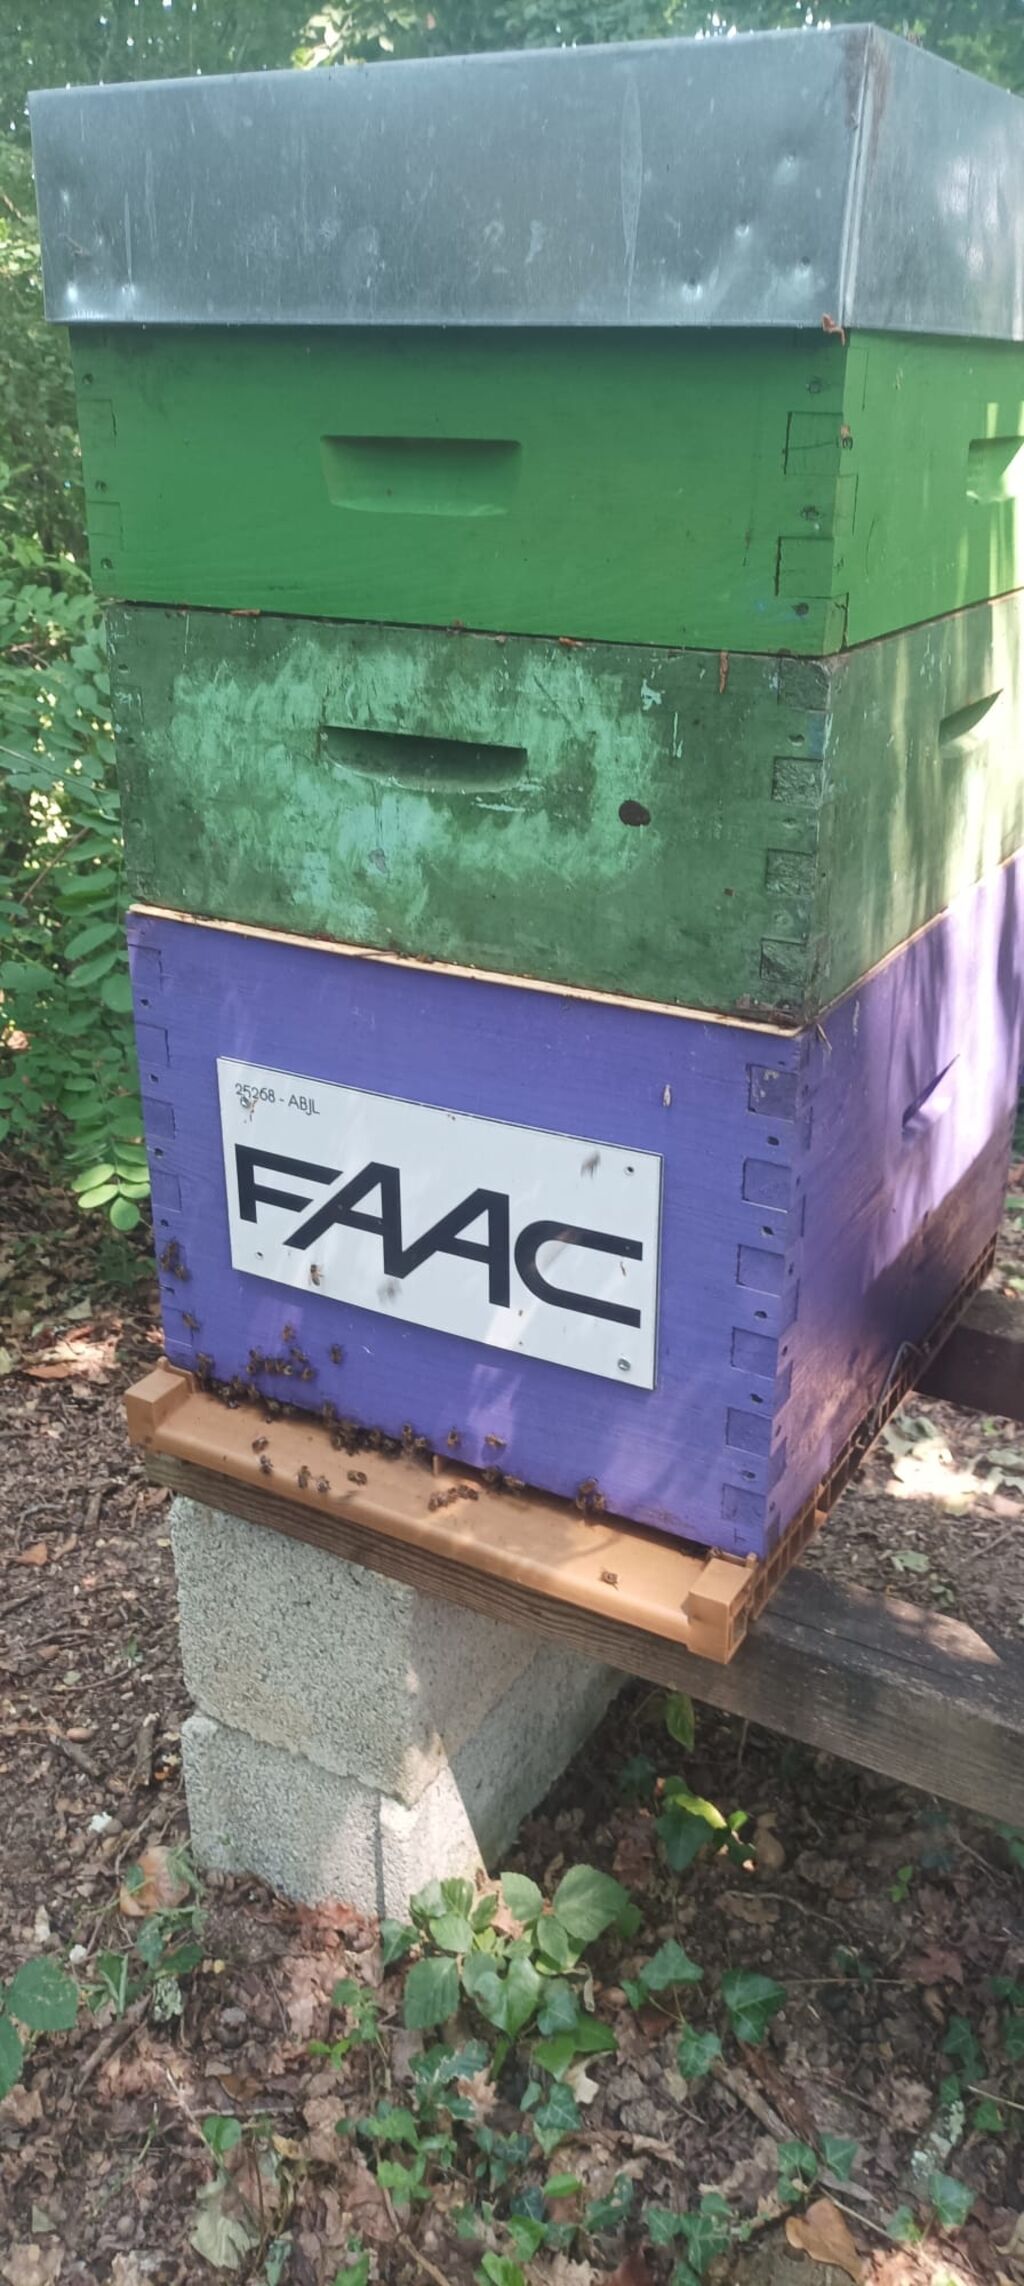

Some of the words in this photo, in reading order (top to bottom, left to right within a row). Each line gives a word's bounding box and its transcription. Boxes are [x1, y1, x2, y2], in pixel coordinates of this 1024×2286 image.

[235, 1083, 276, 1103] 25268
[288, 1094, 320, 1116] ABJL
[234, 1143, 643, 1329] FAAC
